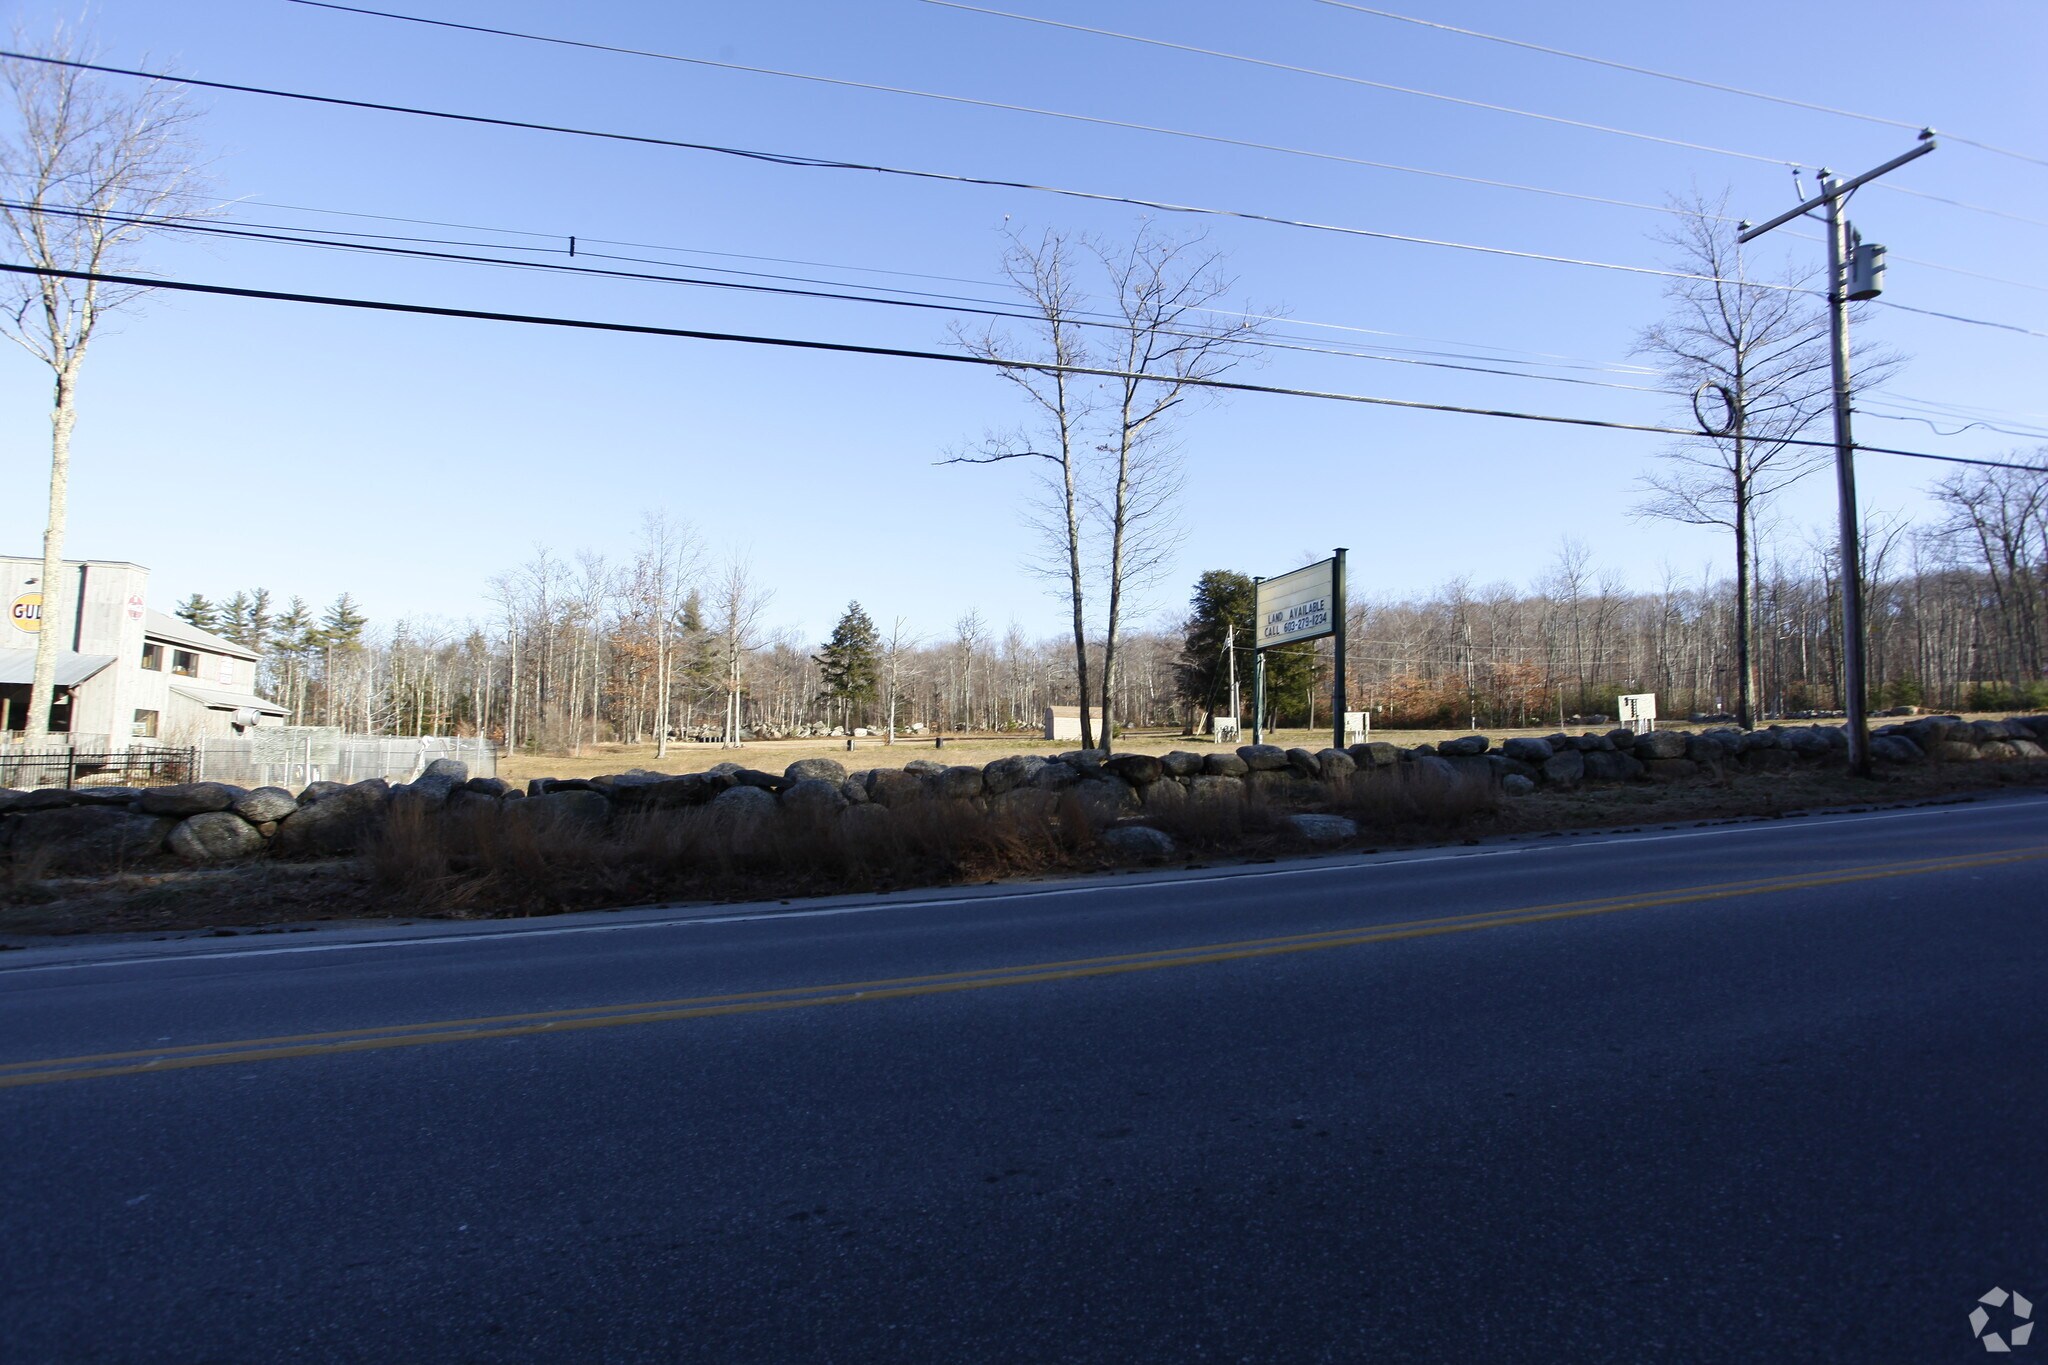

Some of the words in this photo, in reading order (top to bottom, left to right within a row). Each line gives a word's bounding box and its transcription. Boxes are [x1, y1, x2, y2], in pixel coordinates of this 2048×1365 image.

[13, 604, 41, 619] GUL
[1268, 612, 1283, 624] LAND
[1289, 600, 1324, 619] AVAILABLE
[1264, 626, 1280, 637] CALL
